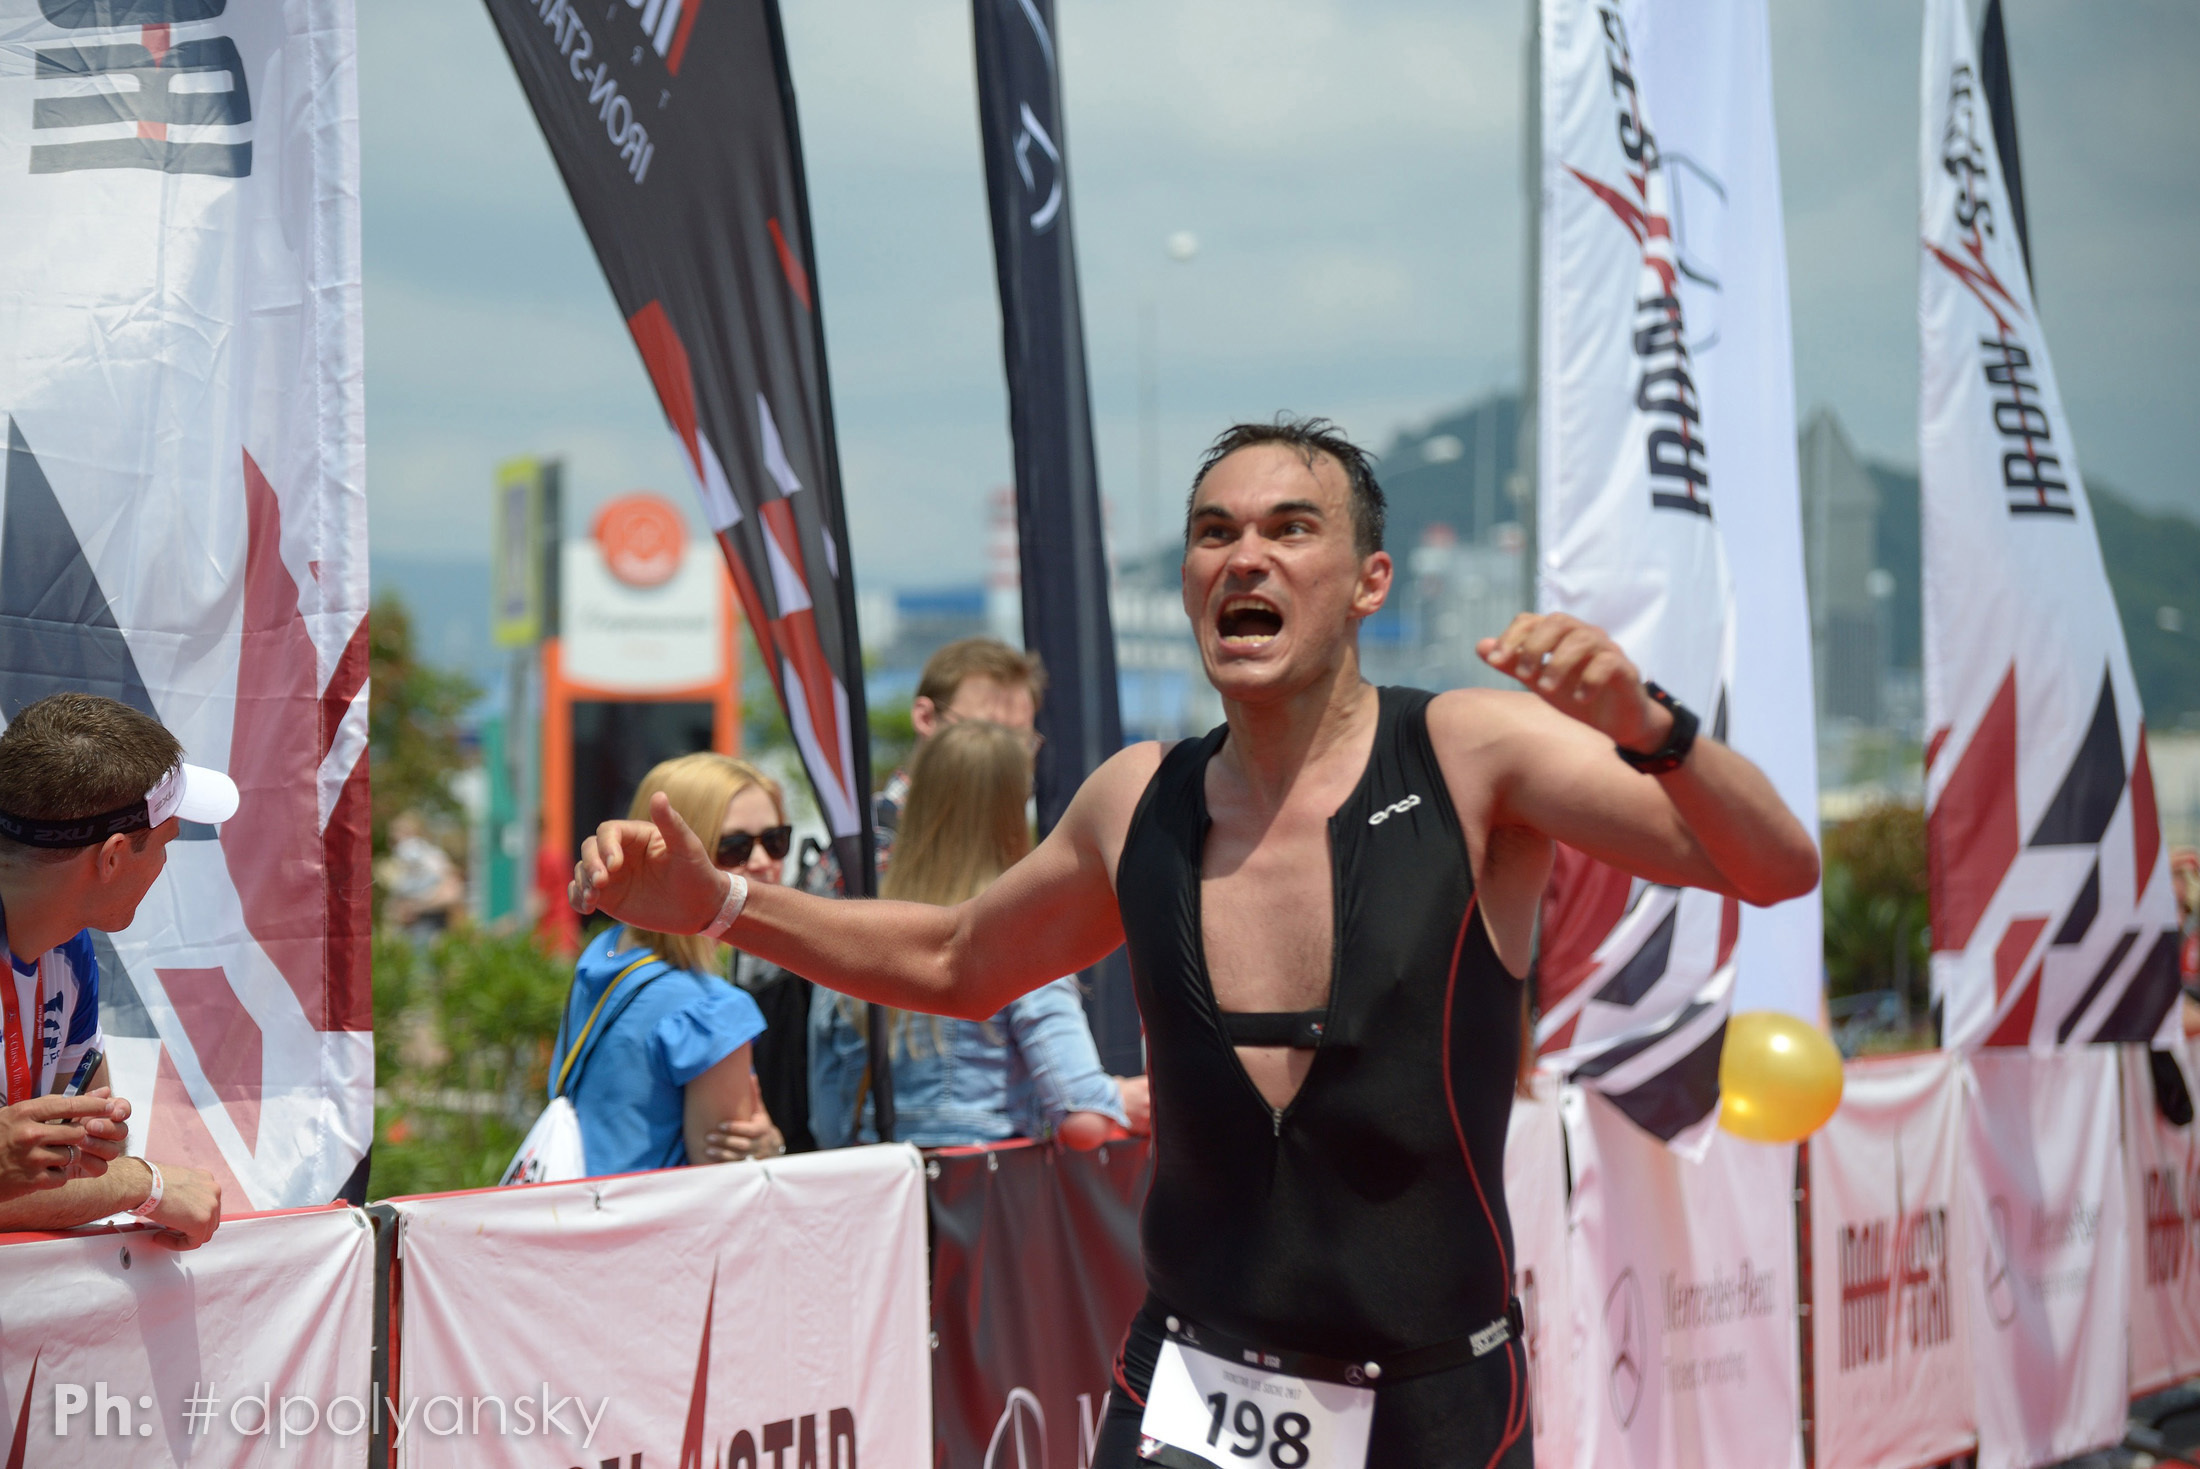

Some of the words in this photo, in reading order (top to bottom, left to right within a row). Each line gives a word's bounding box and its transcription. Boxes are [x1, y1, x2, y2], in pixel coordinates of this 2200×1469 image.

[1979, 338, 2077, 518] IRON
[153, 790, 176, 813] 2XU
[33, 824, 95, 842] 2XU
[1205, 1391, 1311, 1469] 198
